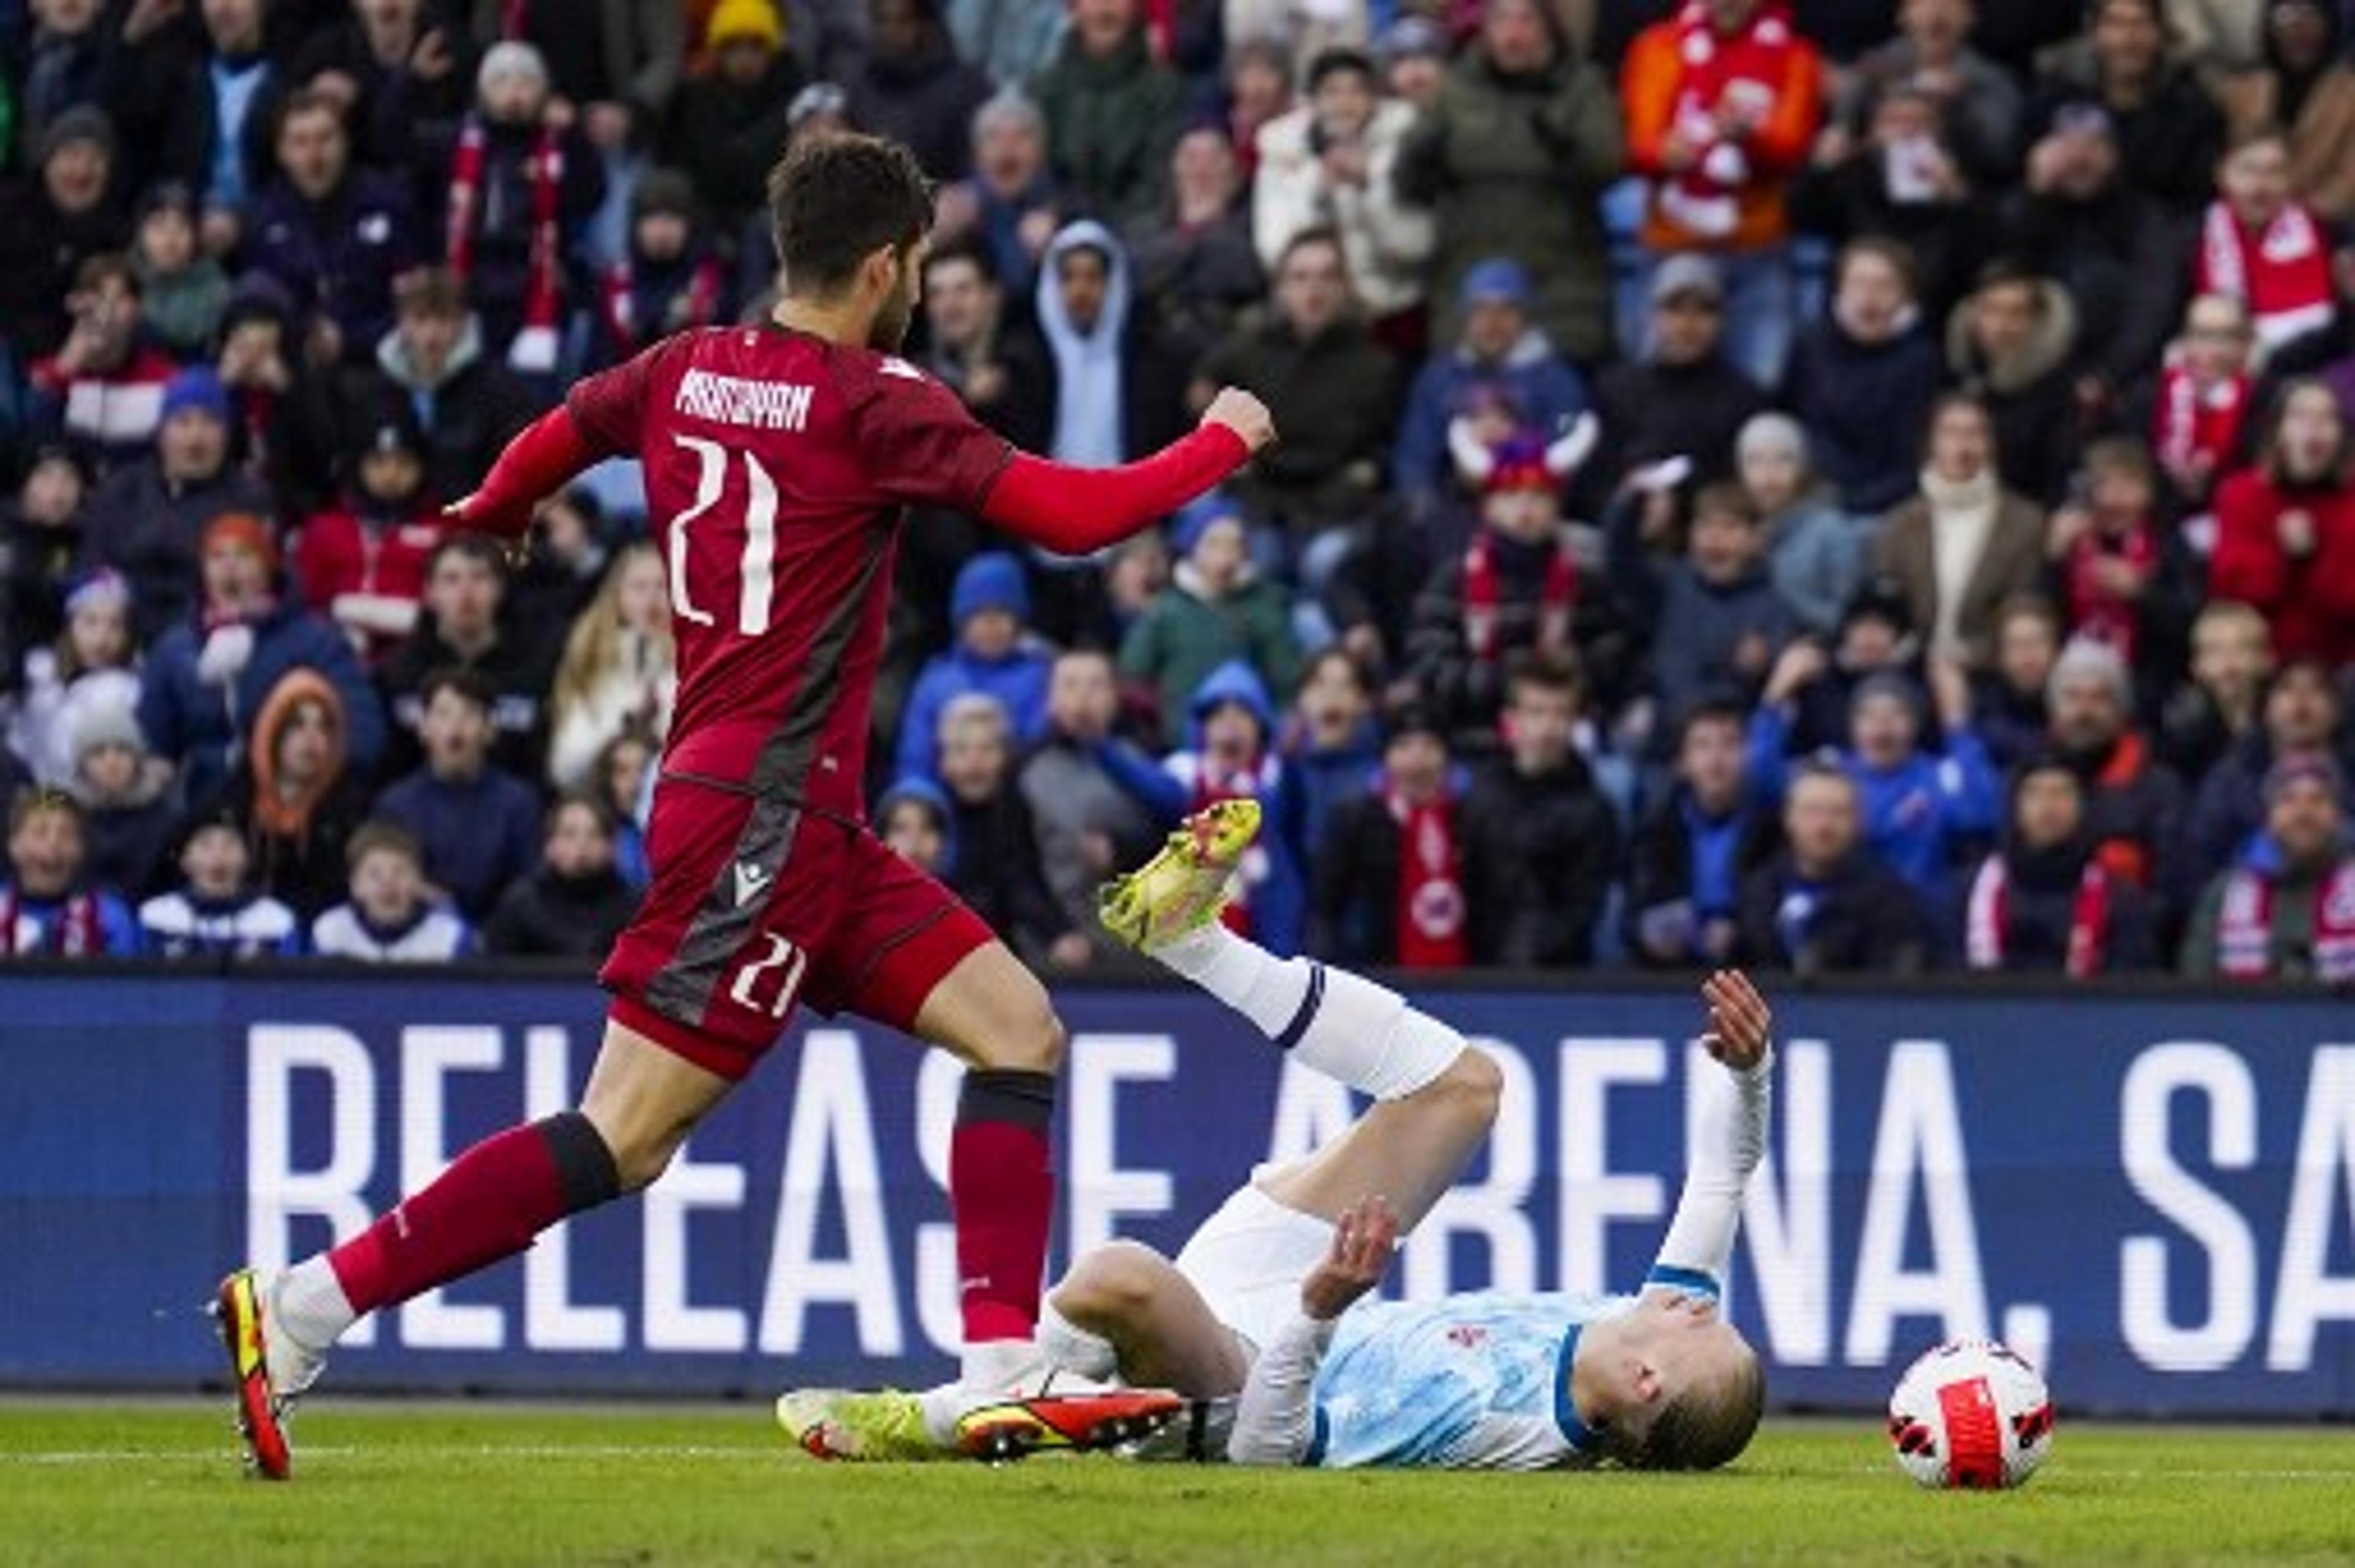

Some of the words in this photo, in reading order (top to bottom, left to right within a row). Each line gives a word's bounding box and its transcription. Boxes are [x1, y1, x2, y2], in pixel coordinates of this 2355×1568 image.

[670, 435, 778, 635] 21
[731, 931, 806, 1017] 21
[1266, 1036, 2051, 1374] RENA,
[2121, 1041, 2355, 1372] SA
